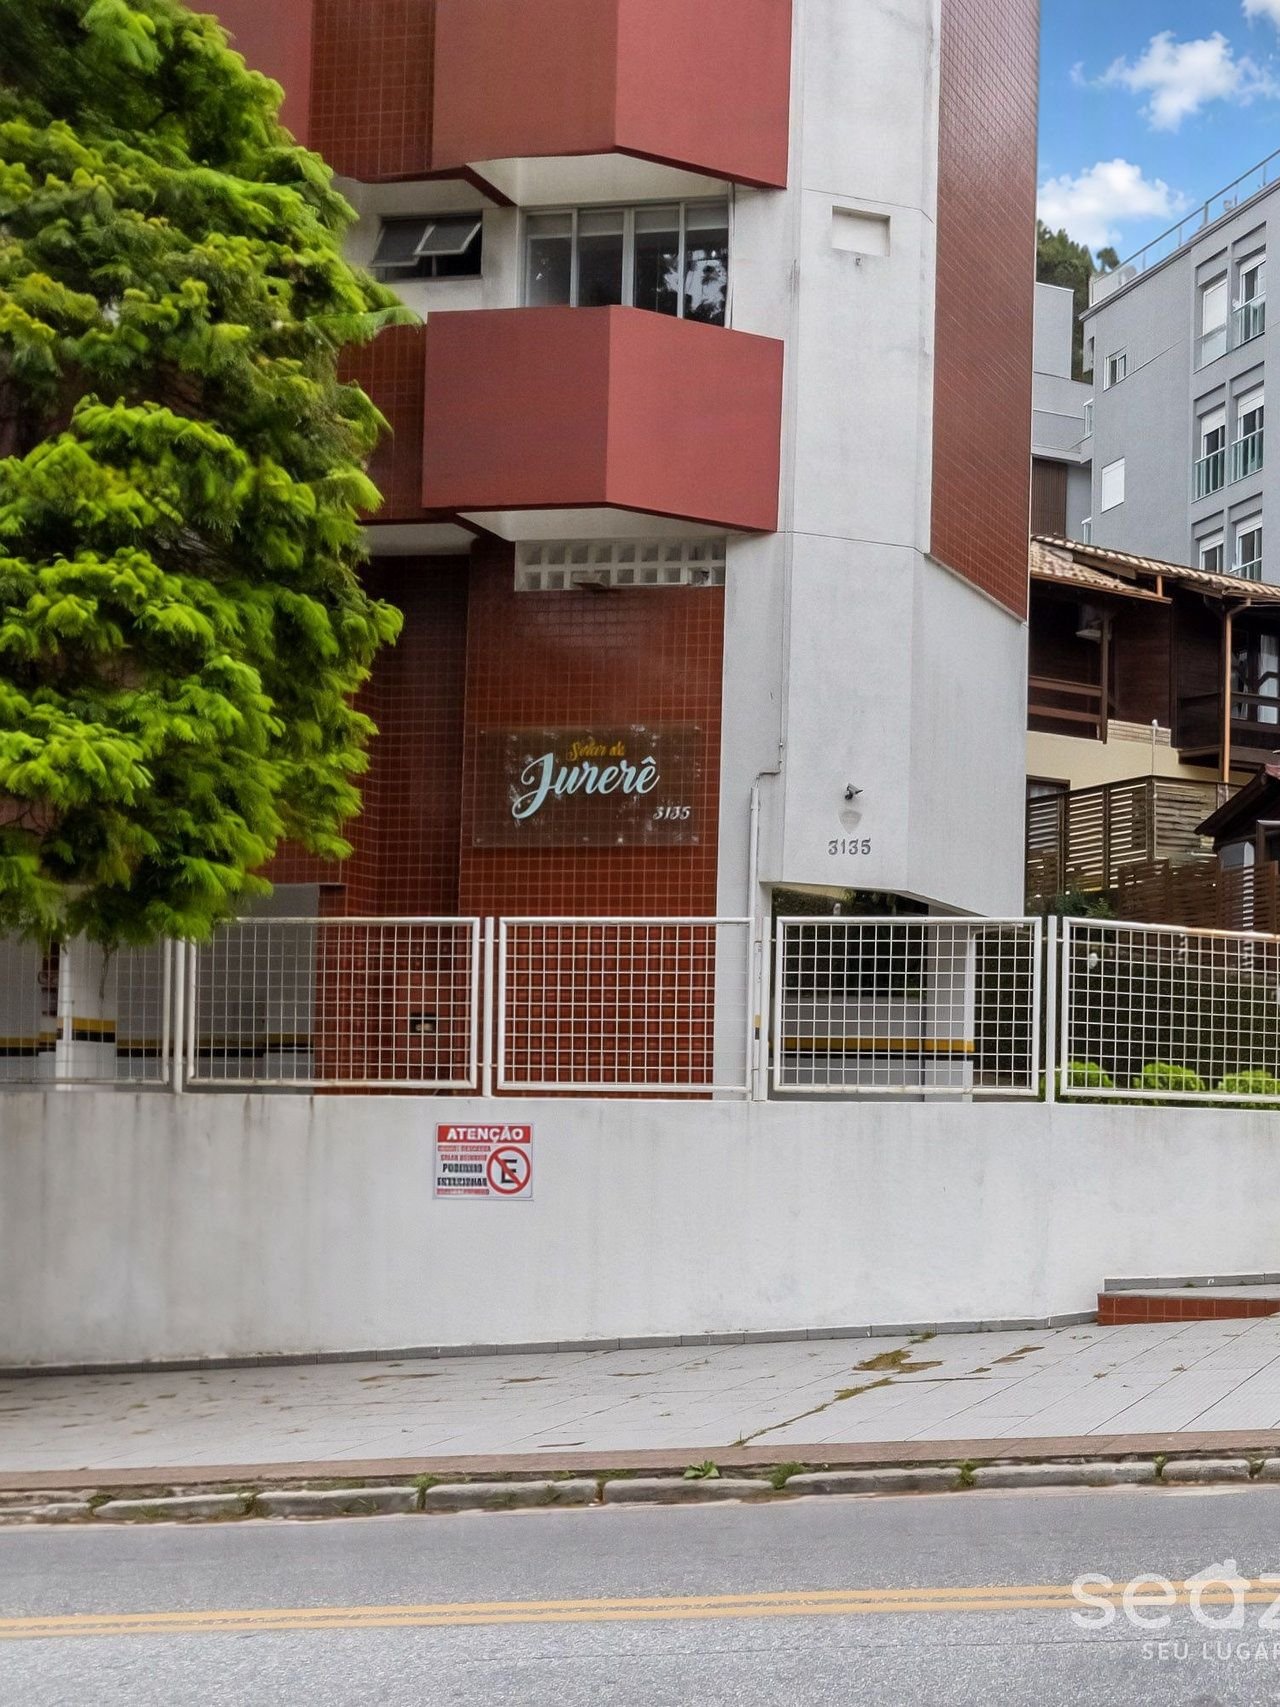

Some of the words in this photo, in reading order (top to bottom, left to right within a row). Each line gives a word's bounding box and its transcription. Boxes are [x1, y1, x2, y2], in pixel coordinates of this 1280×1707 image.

[512, 753, 660, 819] Jurerê
[652, 805, 692, 820] 3135
[828, 837, 872, 856] 3135
[446, 1125, 524, 1144] ATENÇÃO
